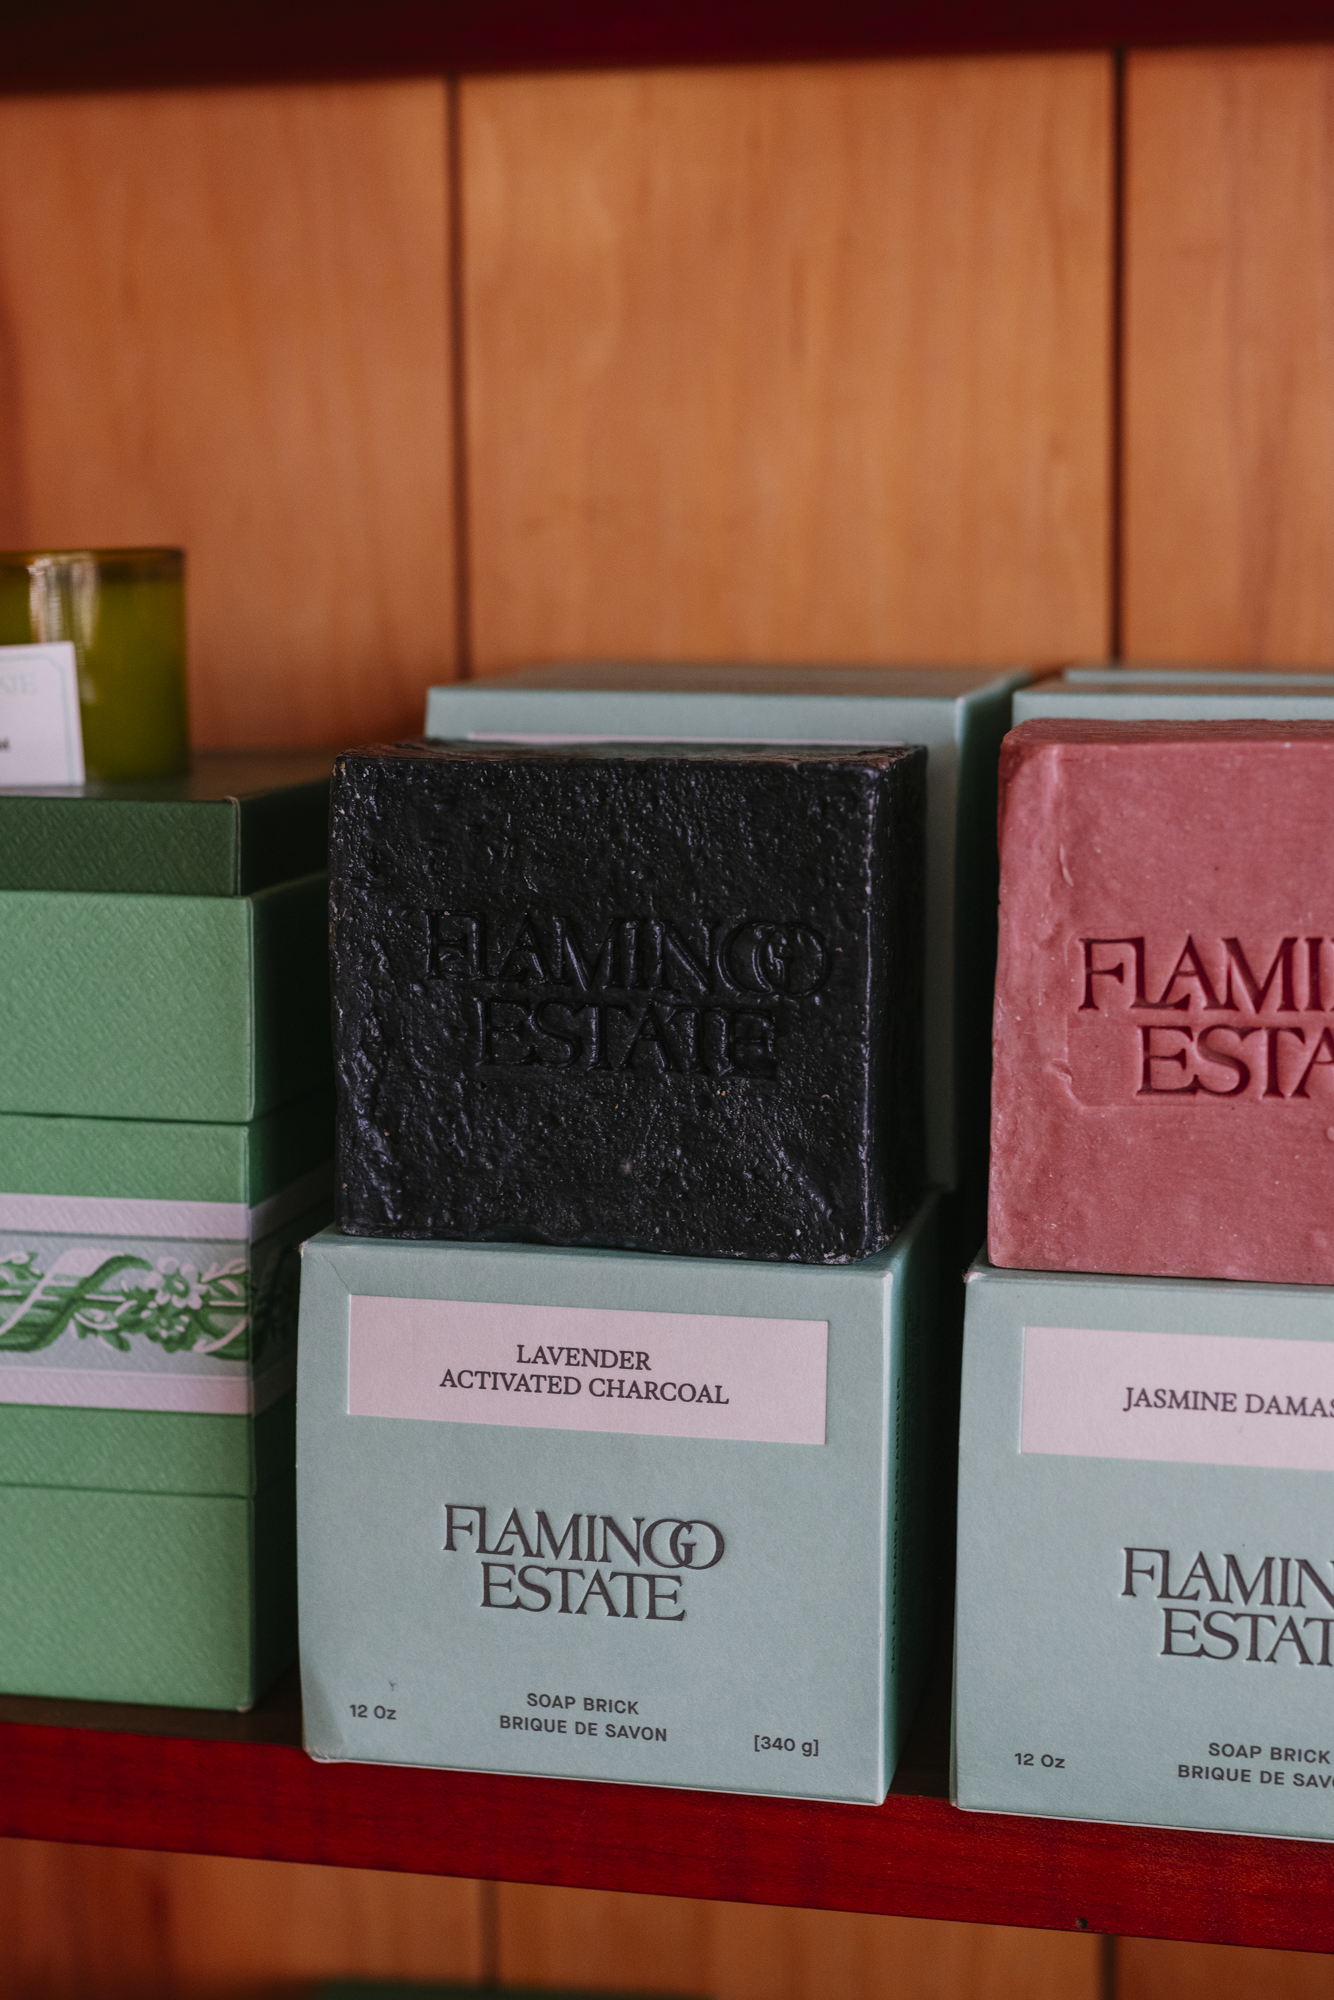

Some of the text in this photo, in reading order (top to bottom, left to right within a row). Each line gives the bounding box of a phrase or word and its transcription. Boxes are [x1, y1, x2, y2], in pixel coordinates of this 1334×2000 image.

[423, 908, 832, 998] FLAMINGO
[1078, 934, 1334, 1014] FLAMI
[473, 996, 778, 1082] ESTATE
[1136, 1024, 1334, 1099] ESTA
[516, 1344, 652, 1371] LAVENDER
[439, 1368, 730, 1405] ACTIVATED CHARCOAL
[1122, 1386, 1238, 1412] JASMINE
[442, 1504, 726, 1571] FLAMINGO
[479, 1561, 686, 1622] ESTATE
[1120, 1547, 1334, 1612] FLAMIN
[1160, 1607, 1334, 1667] ESTAT
[349, 1704, 397, 1721] 12 Oz
[526, 1692, 639, 1715] SOAP BRICK
[499, 1714, 667, 1742] BRIQUE DE SAVON
[754, 1734, 820, 1758] [340 g]
[1014, 1752, 1066, 1769] 12 Oz
[1208, 1742, 1331, 1765] SOAP BRICK
[1177, 1764, 1334, 1789] BRIQUE DE SAV
